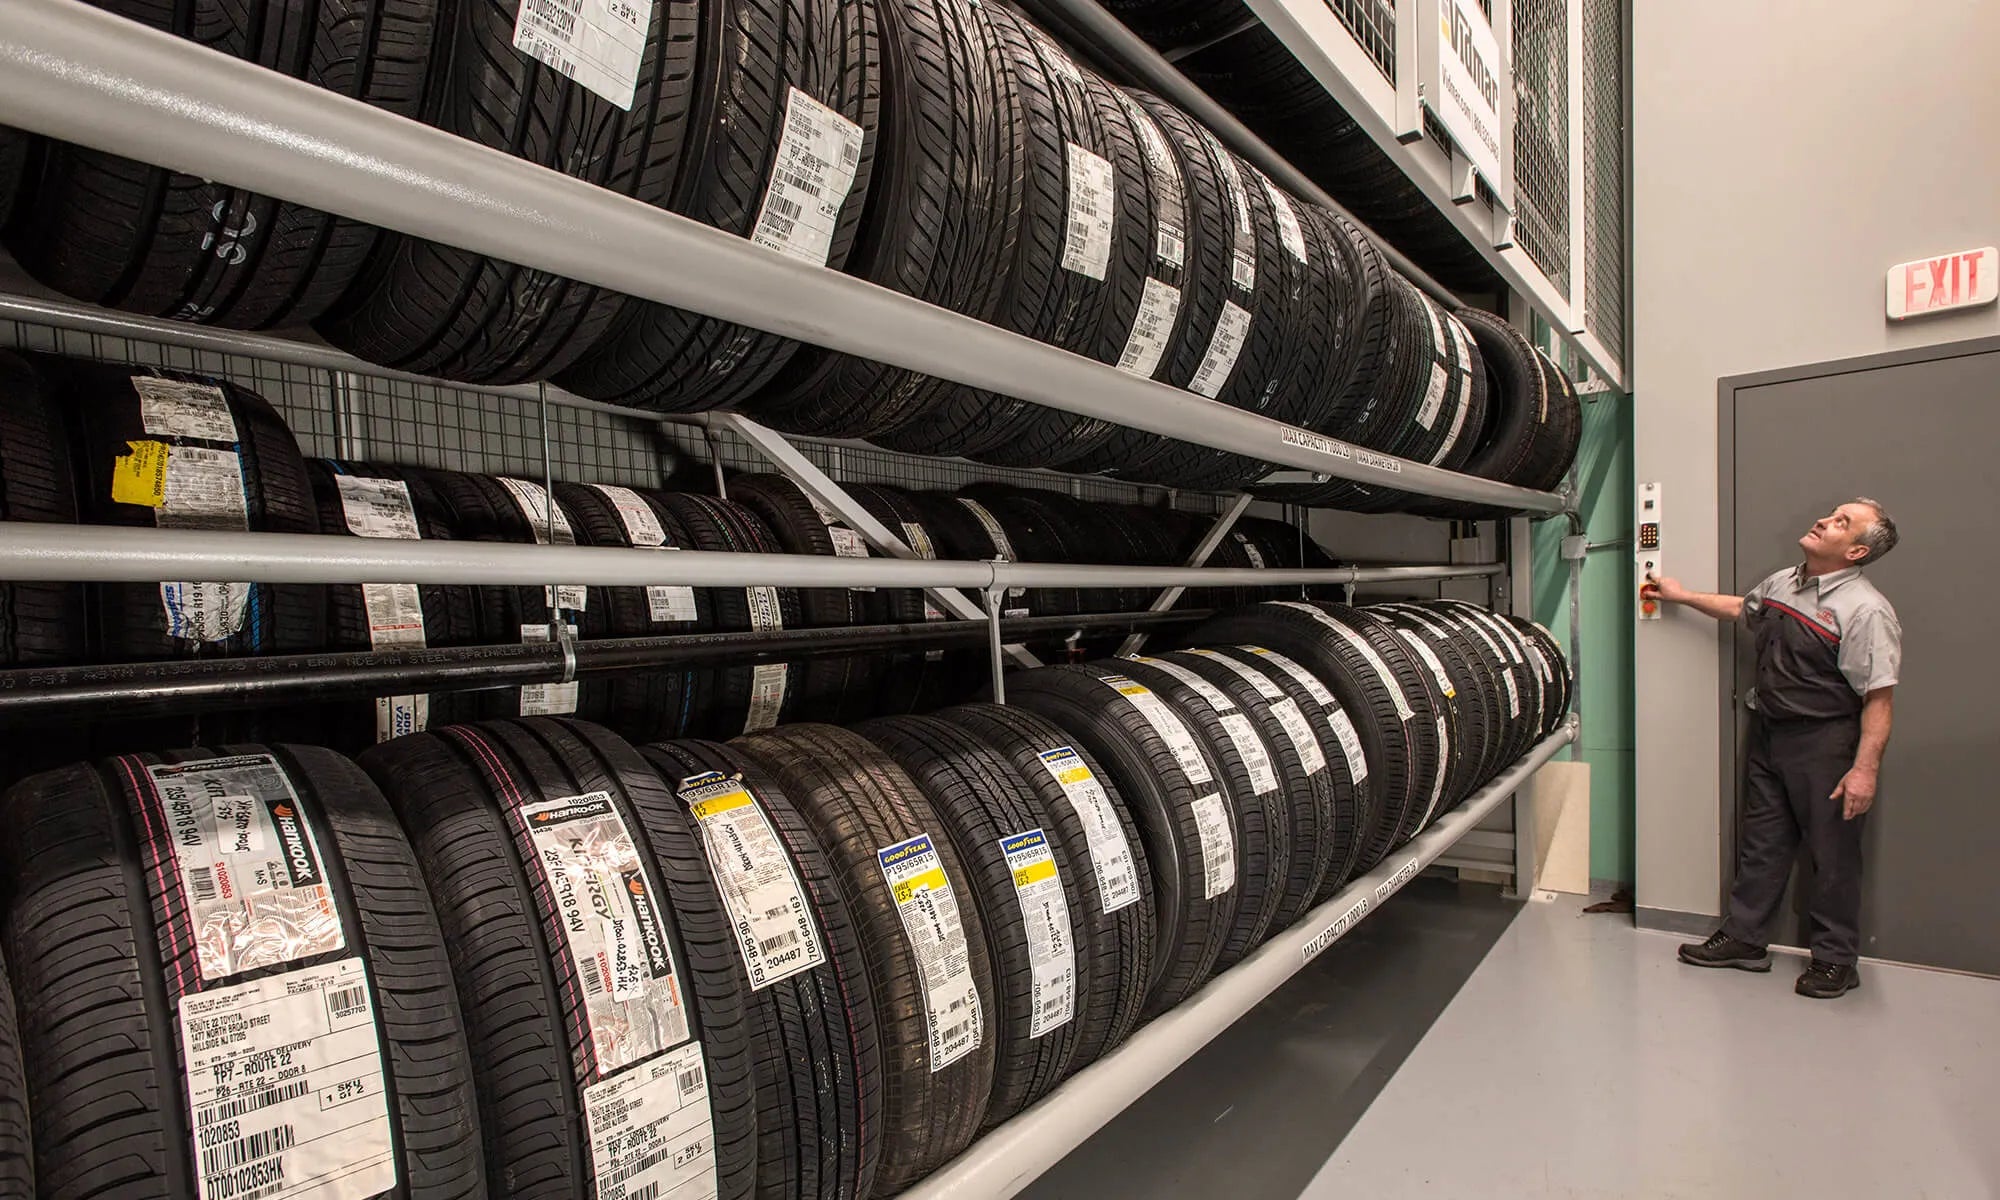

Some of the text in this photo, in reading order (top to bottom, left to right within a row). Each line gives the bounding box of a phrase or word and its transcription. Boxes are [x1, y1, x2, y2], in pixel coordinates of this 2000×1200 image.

[611, 3, 637, 25] 2 of 4
[521, 27, 534, 39] CC
[1905, 251, 1984, 313] EXIT
[1282, 427, 1299, 444] MAX
[1299, 432, 1328, 453] CAPACITY
[567, 793, 606, 806] 1020853
[180, 827, 203, 846] 94V
[1006, 836, 1042, 851] GOODYEAR
[883, 842, 927, 864] GOODYEAR
[885, 852, 935, 878] P195/65R15
[897, 888, 912, 902] LS-2
[566, 908, 586, 933] 94V
[790, 895, 818, 961] 706-648-163
[1302, 941, 1319, 961] MAX
[1318, 919, 1347, 950] CAPACITY
[765, 947, 802, 970] 204487
[190, 1012, 243, 1034] ROUTE 22 TOYOTA
[335, 1005, 367, 1019] 30257703
[191, 1013, 271, 1043] 1477 NORTH BROAD STREET
[191, 1039, 220, 1054] HILLSIDE
[220, 1035, 229, 1046] NJ
[248, 1049, 275, 1063] LOCAL
[275, 1039, 313, 1056] DELIVERY
[279, 1052, 293, 1067] 22
[256, 1075, 266, 1087] 22
[278, 1066, 299, 1080] DOOR
[336, 1078, 362, 1093] SKU
[326, 1084, 365, 1103] 1 of 2
[199, 1120, 241, 1149] 1020853
[684, 1142, 701, 1154] SKU
[677, 1156, 683, 1164] 2
[206, 1155, 285, 1200] DT00102853HK
